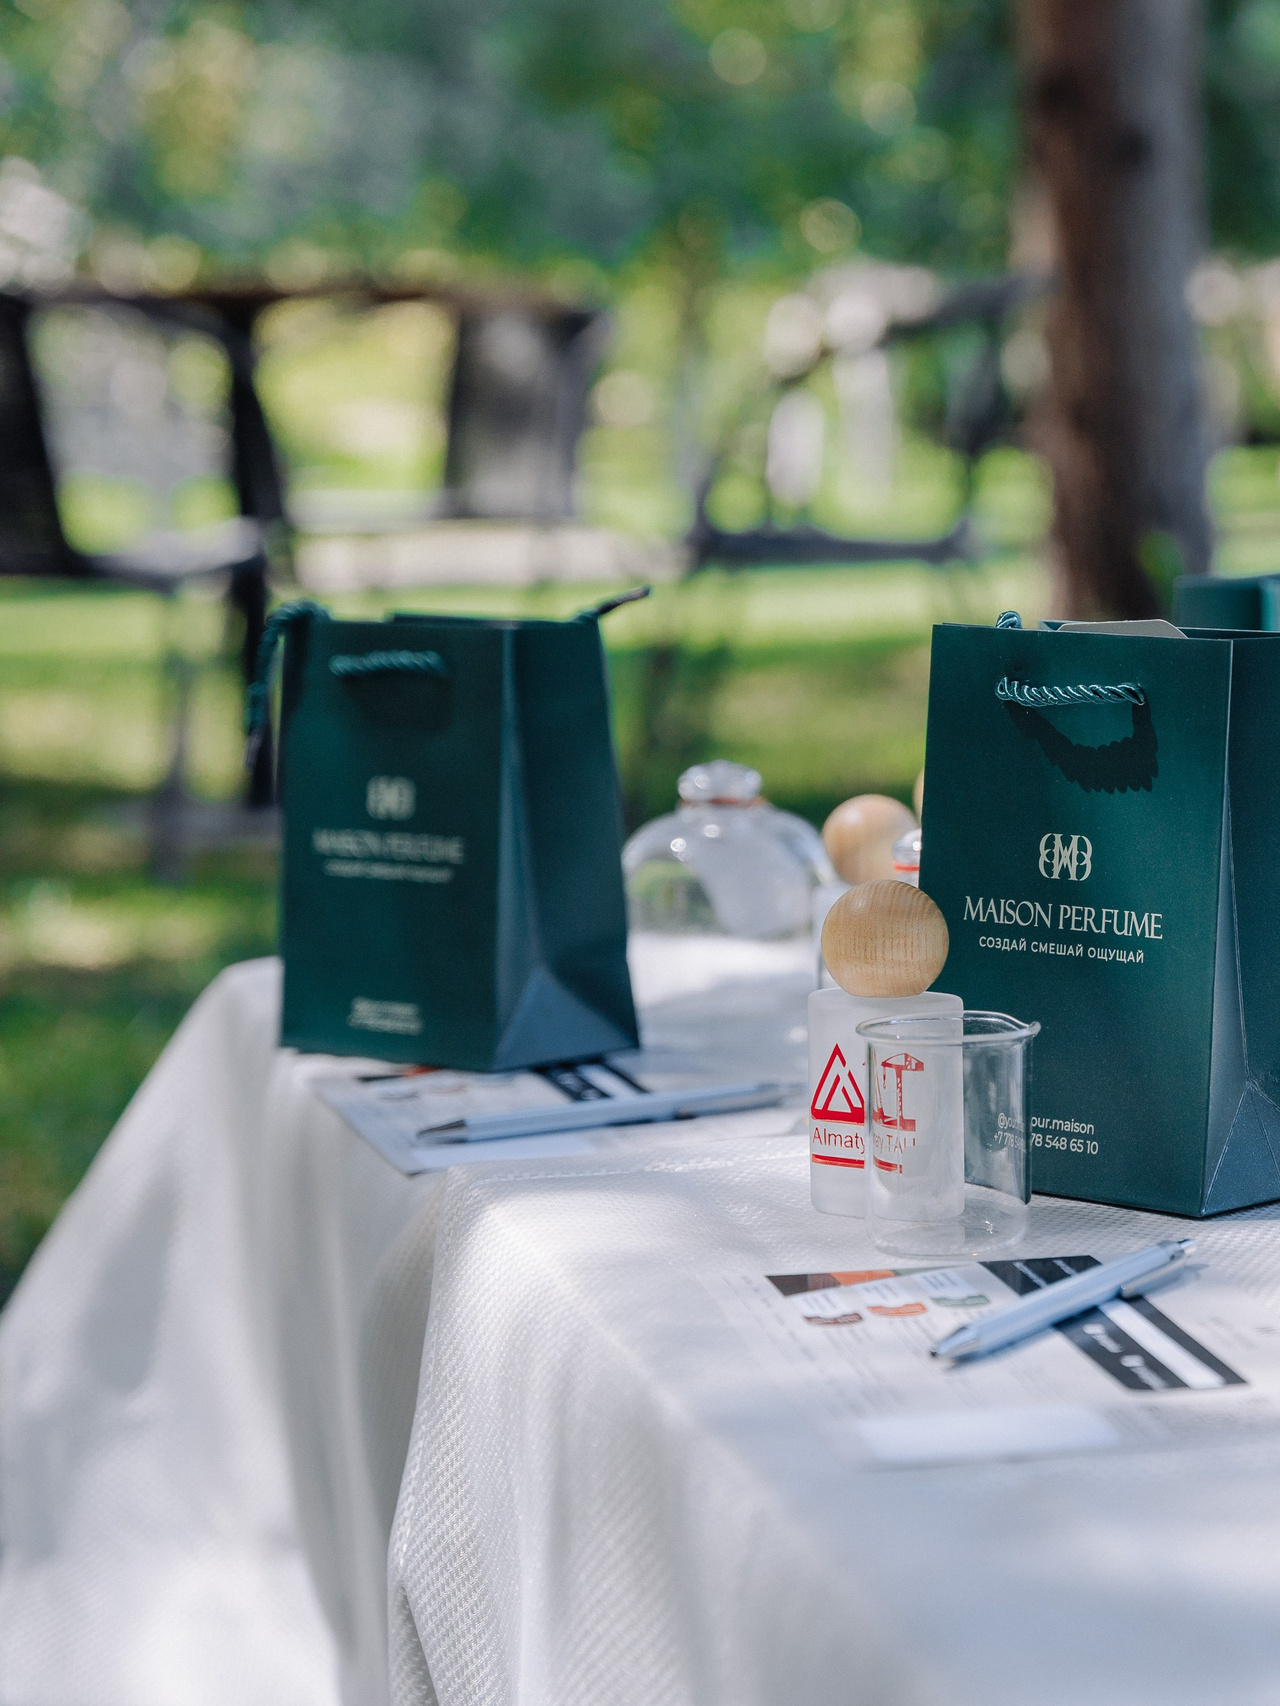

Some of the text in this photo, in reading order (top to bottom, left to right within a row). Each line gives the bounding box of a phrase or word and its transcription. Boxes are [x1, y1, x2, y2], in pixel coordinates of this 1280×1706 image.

[963, 896, 1163, 940] MAISON PERFUME
[979, 936, 1144, 963] СОЗДАЙ СМЕШАЙ ОЩУЩАЙ
[812, 1127, 865, 1154] Almaty
[1045, 1135, 1067, 1150] 548
[1070, 1139, 1084, 1153] 65
[1086, 1140, 1099, 1155] 10
